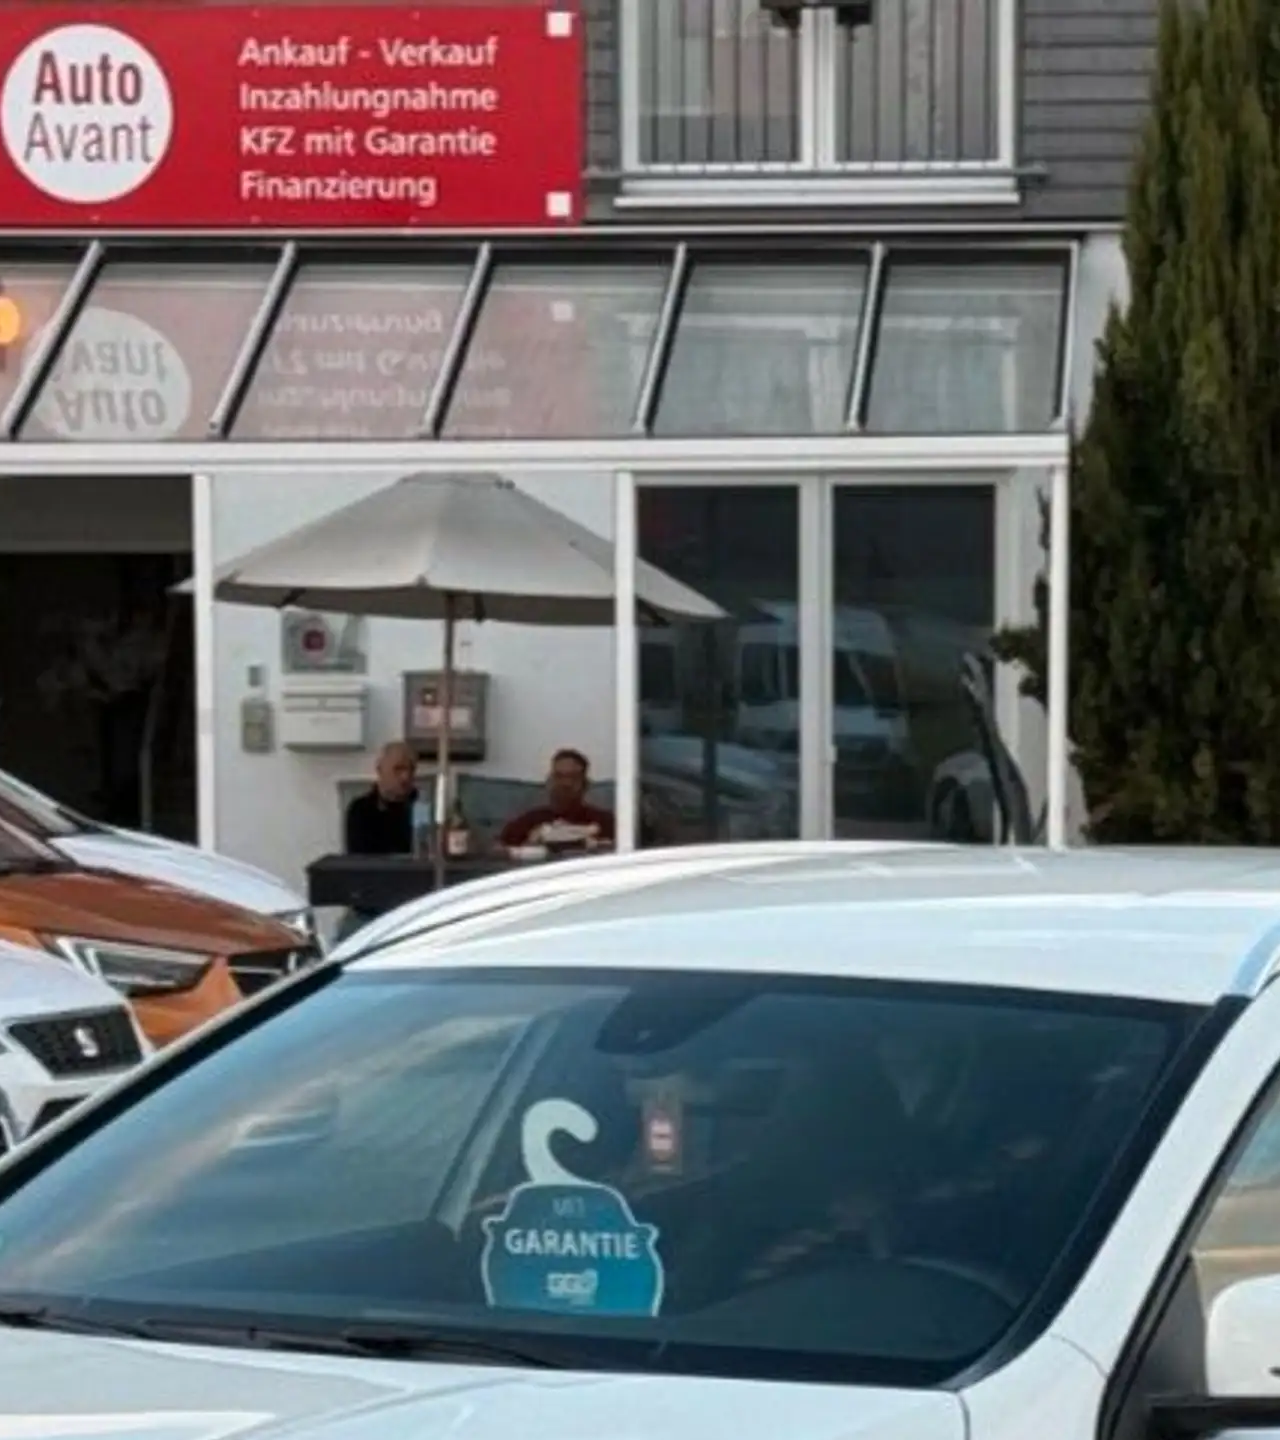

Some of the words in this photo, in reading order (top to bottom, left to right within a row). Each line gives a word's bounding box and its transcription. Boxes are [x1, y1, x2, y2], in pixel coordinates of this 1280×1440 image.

[239, 39, 348, 67] Ankauf
[382, 38, 498, 67] Verkauf
[34, 52, 142, 106] Auto
[239, 84, 498, 115] Inzahlungnahme
[23, 114, 155, 163] Avant
[240, 129, 293, 155] KFZ
[305, 128, 356, 155] mit
[367, 128, 498, 155] Garantie
[240, 171, 437, 203] Finanzierung
[505, 1228, 639, 1259] GARANTIE
